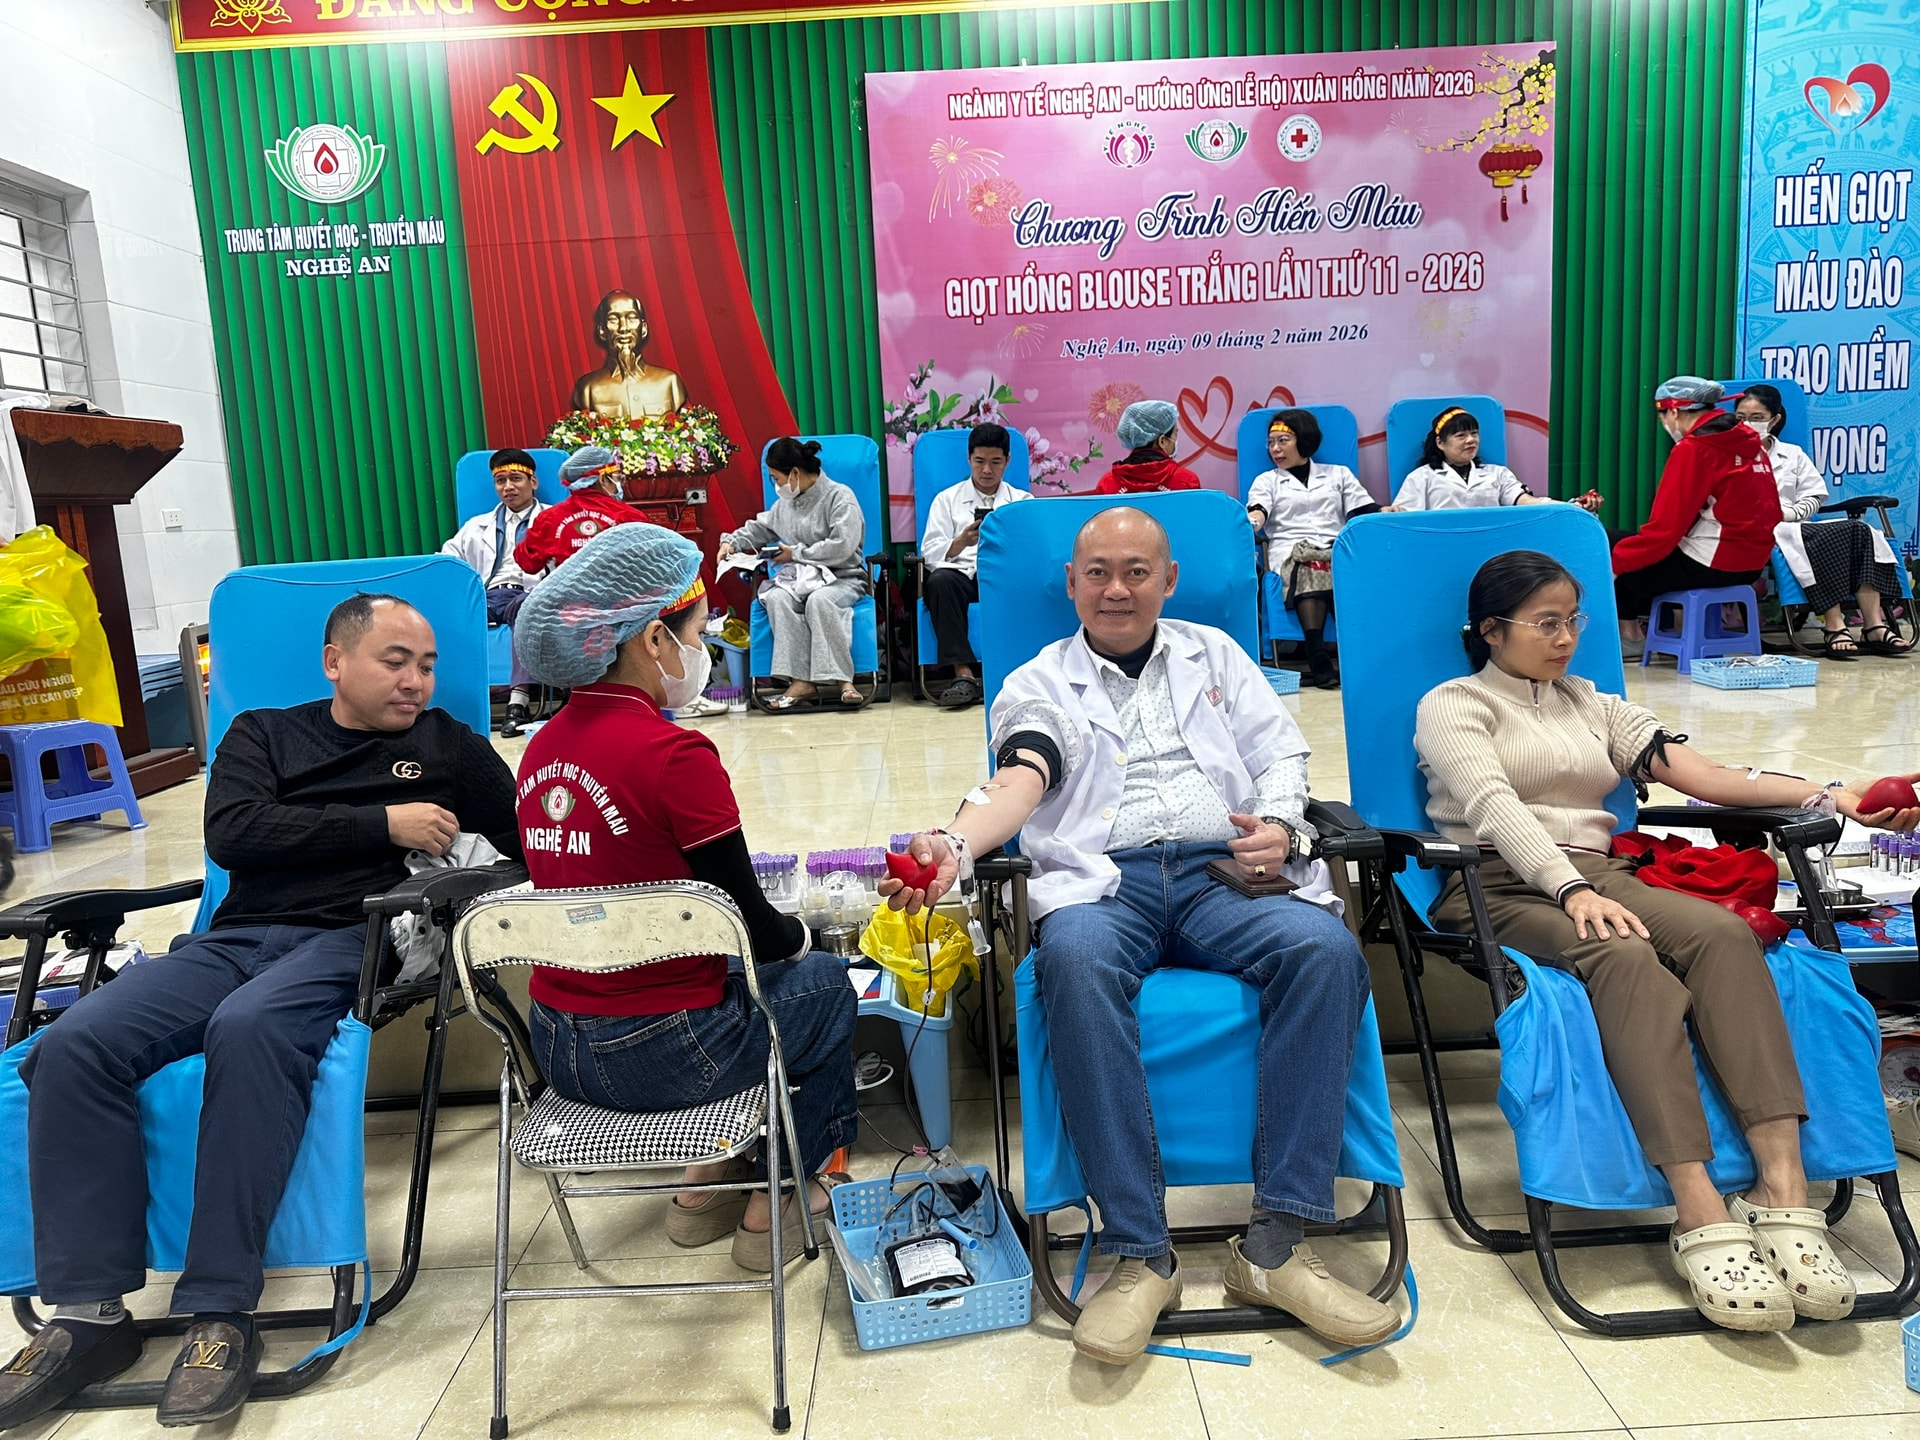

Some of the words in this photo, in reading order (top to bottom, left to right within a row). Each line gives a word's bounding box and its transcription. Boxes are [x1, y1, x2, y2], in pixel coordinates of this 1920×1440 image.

[948, 87, 1007, 119] NGÀNH
[1009, 91, 1022, 117] Y
[1024, 82, 1046, 116] TẾ
[1049, 82, 1094, 118] NGHỆ
[1097, 86, 1122, 113] AN
[1135, 76, 1194, 111] HƯỞNG
[1197, 77, 1232, 109] ỨNG
[1235, 72, 1255, 106] LỄ
[1259, 74, 1288, 111] HỘI
[1291, 72, 1338, 104] XUÂN
[1340, 67, 1387, 102] HỒNG
[1391, 68, 1431, 99] NĂM
[1433, 70, 1474, 97] 2026
[1011, 199, 1124, 260] Chương
[1137, 191, 1229, 239] Trình
[1236, 187, 1322, 235] Hiến
[1327, 183, 1421, 232] Máu
[1774, 158, 1842, 228] HIẾN
[1847, 169, 1913, 234] GIỌT
[224, 228, 265, 253] TRUNG
[266, 222, 293, 251] TÂM
[294, 217, 332, 250] HUYẾT
[334, 224, 359, 252] HỌC
[417, 216, 445, 245] MÁU
[284, 253, 352, 279] NGHỆ
[357, 255, 391, 273] AN
[945, 276, 999, 325] GIỌT
[1005, 261, 1073, 315] HỒNG
[1078, 267, 1171, 311] BLOUSE
[1176, 250, 1258, 305] TRẮNG
[1263, 247, 1312, 301] LẦN
[1317, 249, 1368, 297] THỨ
[1370, 256, 1399, 295] 11
[1406, 271, 1419, 282] -
[1422, 251, 1484, 292] 2026
[1774, 250, 1840, 313] MÁU
[1845, 247, 1904, 309] ĐÀO
[1061, 339, 1107, 359] Nghệ
[1110, 337, 1140, 356] An,
[1145, 333, 1187, 354] ngày
[1191, 333, 1212, 349] 09
[1216, 327, 1265, 350] tháng
[1270, 328, 1281, 345] 2
[1285, 328, 1323, 343] năm
[1328, 323, 1369, 342] 2026
[1760, 343, 1831, 396] TRAO
[1836, 325, 1911, 392] NIỀM
[1812, 424, 1888, 486] VỌNG
[536, 758, 562, 784] HUYẾT
[562, 762, 580, 782] HỌC
[601, 804, 629, 836] MÁU
[526, 824, 563, 857] NGHỆ
[566, 830, 591, 856] AN
